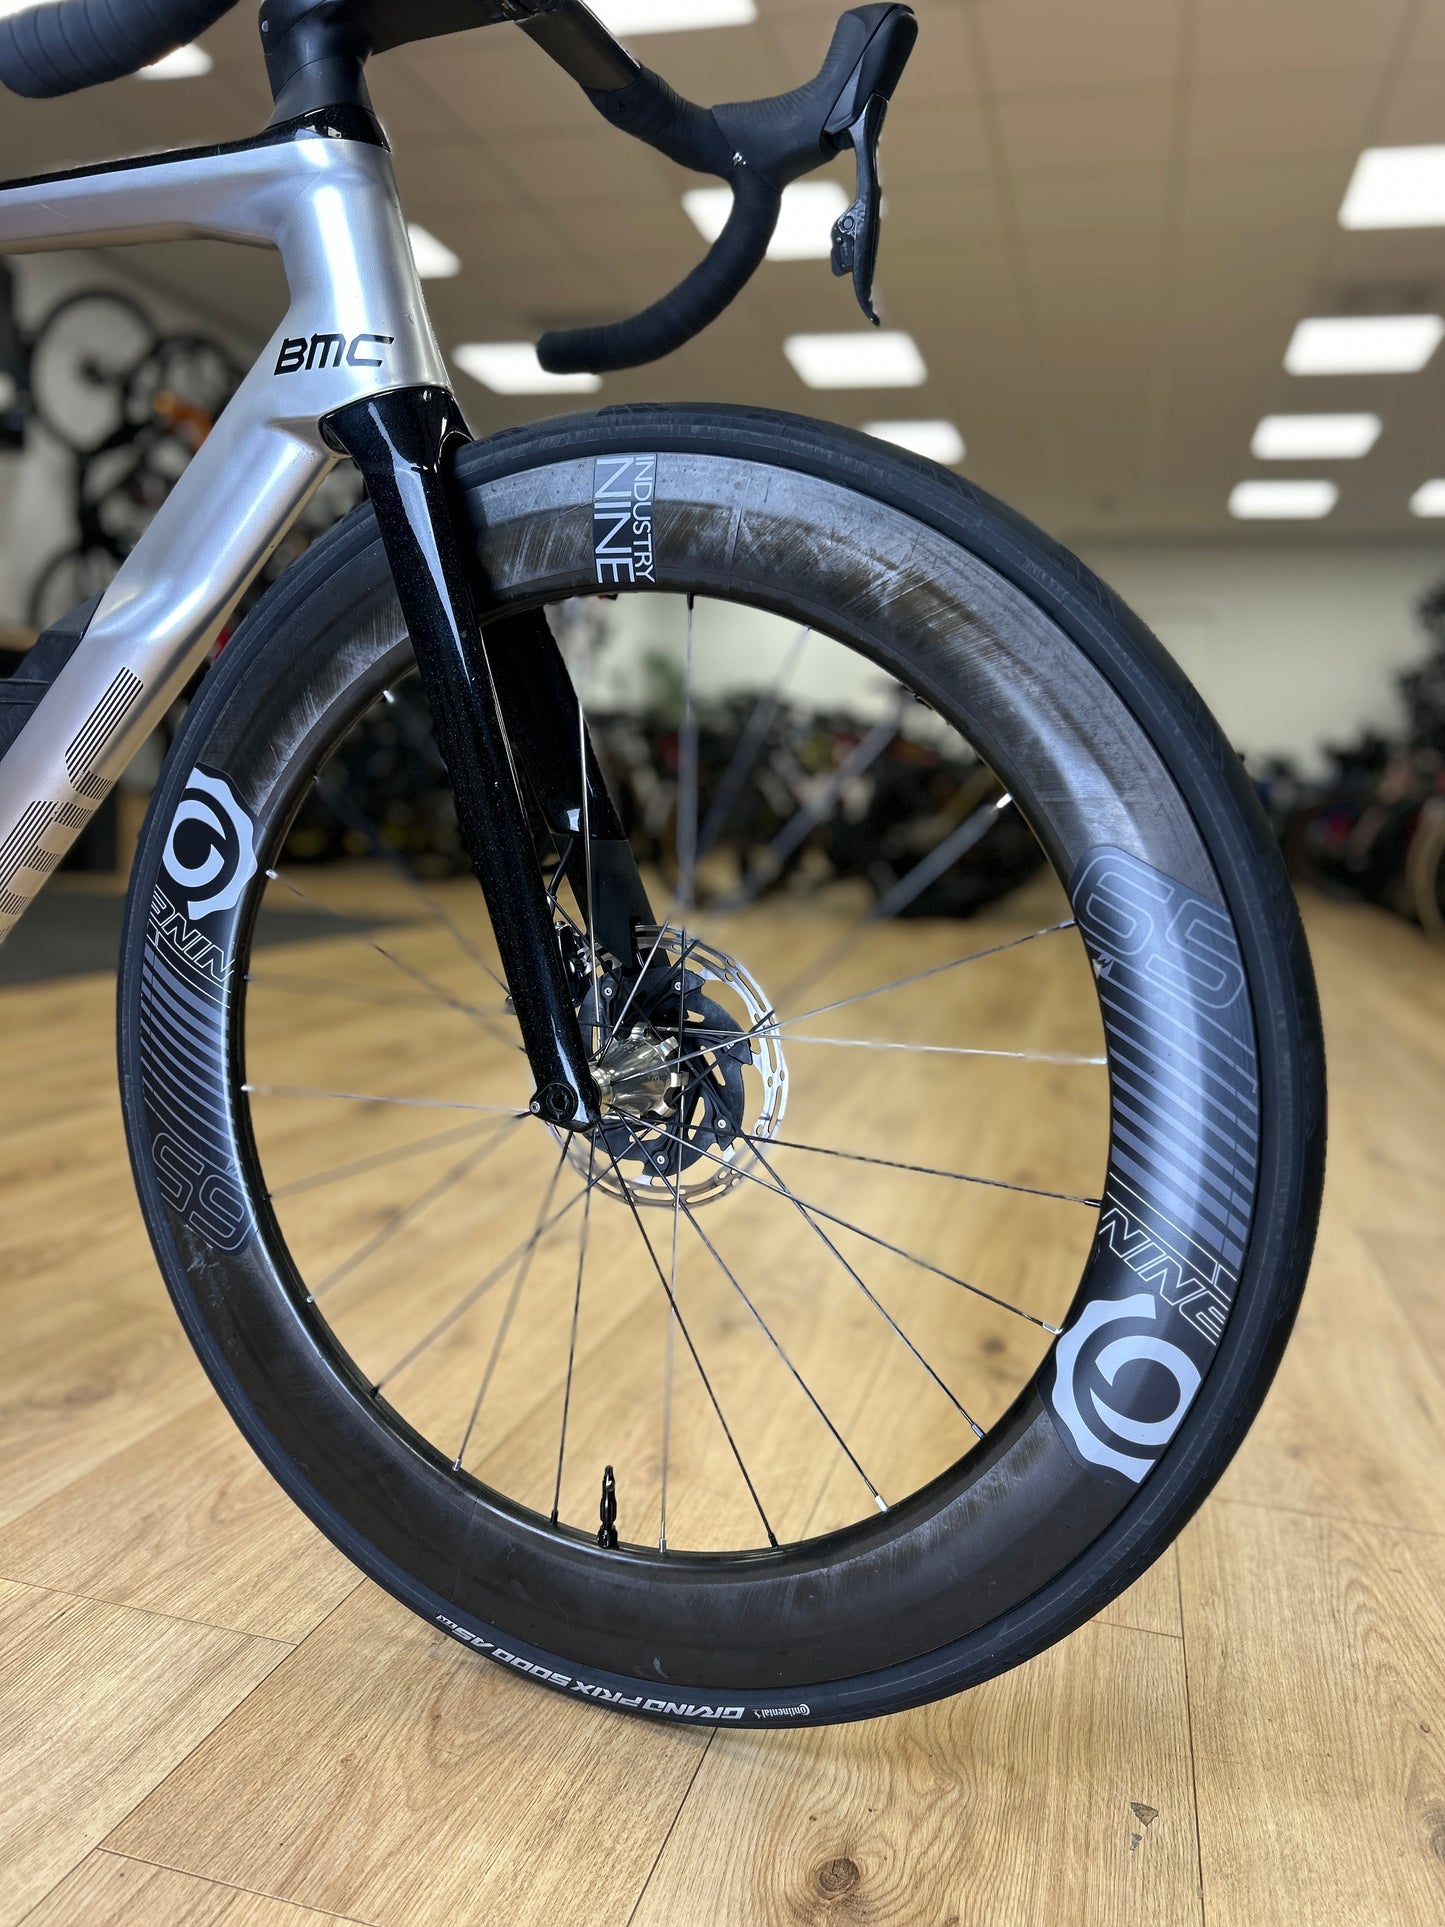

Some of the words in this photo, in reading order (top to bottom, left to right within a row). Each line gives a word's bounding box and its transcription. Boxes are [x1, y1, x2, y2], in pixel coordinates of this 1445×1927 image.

[274, 333, 394, 375] BMC
[594, 457, 635, 584] NINE
[633, 455, 656, 583] INDUSTRY
[1072, 855, 1244, 1009] 65
[1099, 1208, 1229, 1346] NINE
[491, 1647, 572, 1688] 5000
[570, 1680, 643, 1708] PRIX
[642, 1698, 745, 1720] GRAND
[760, 1703, 811, 1719] Continental
